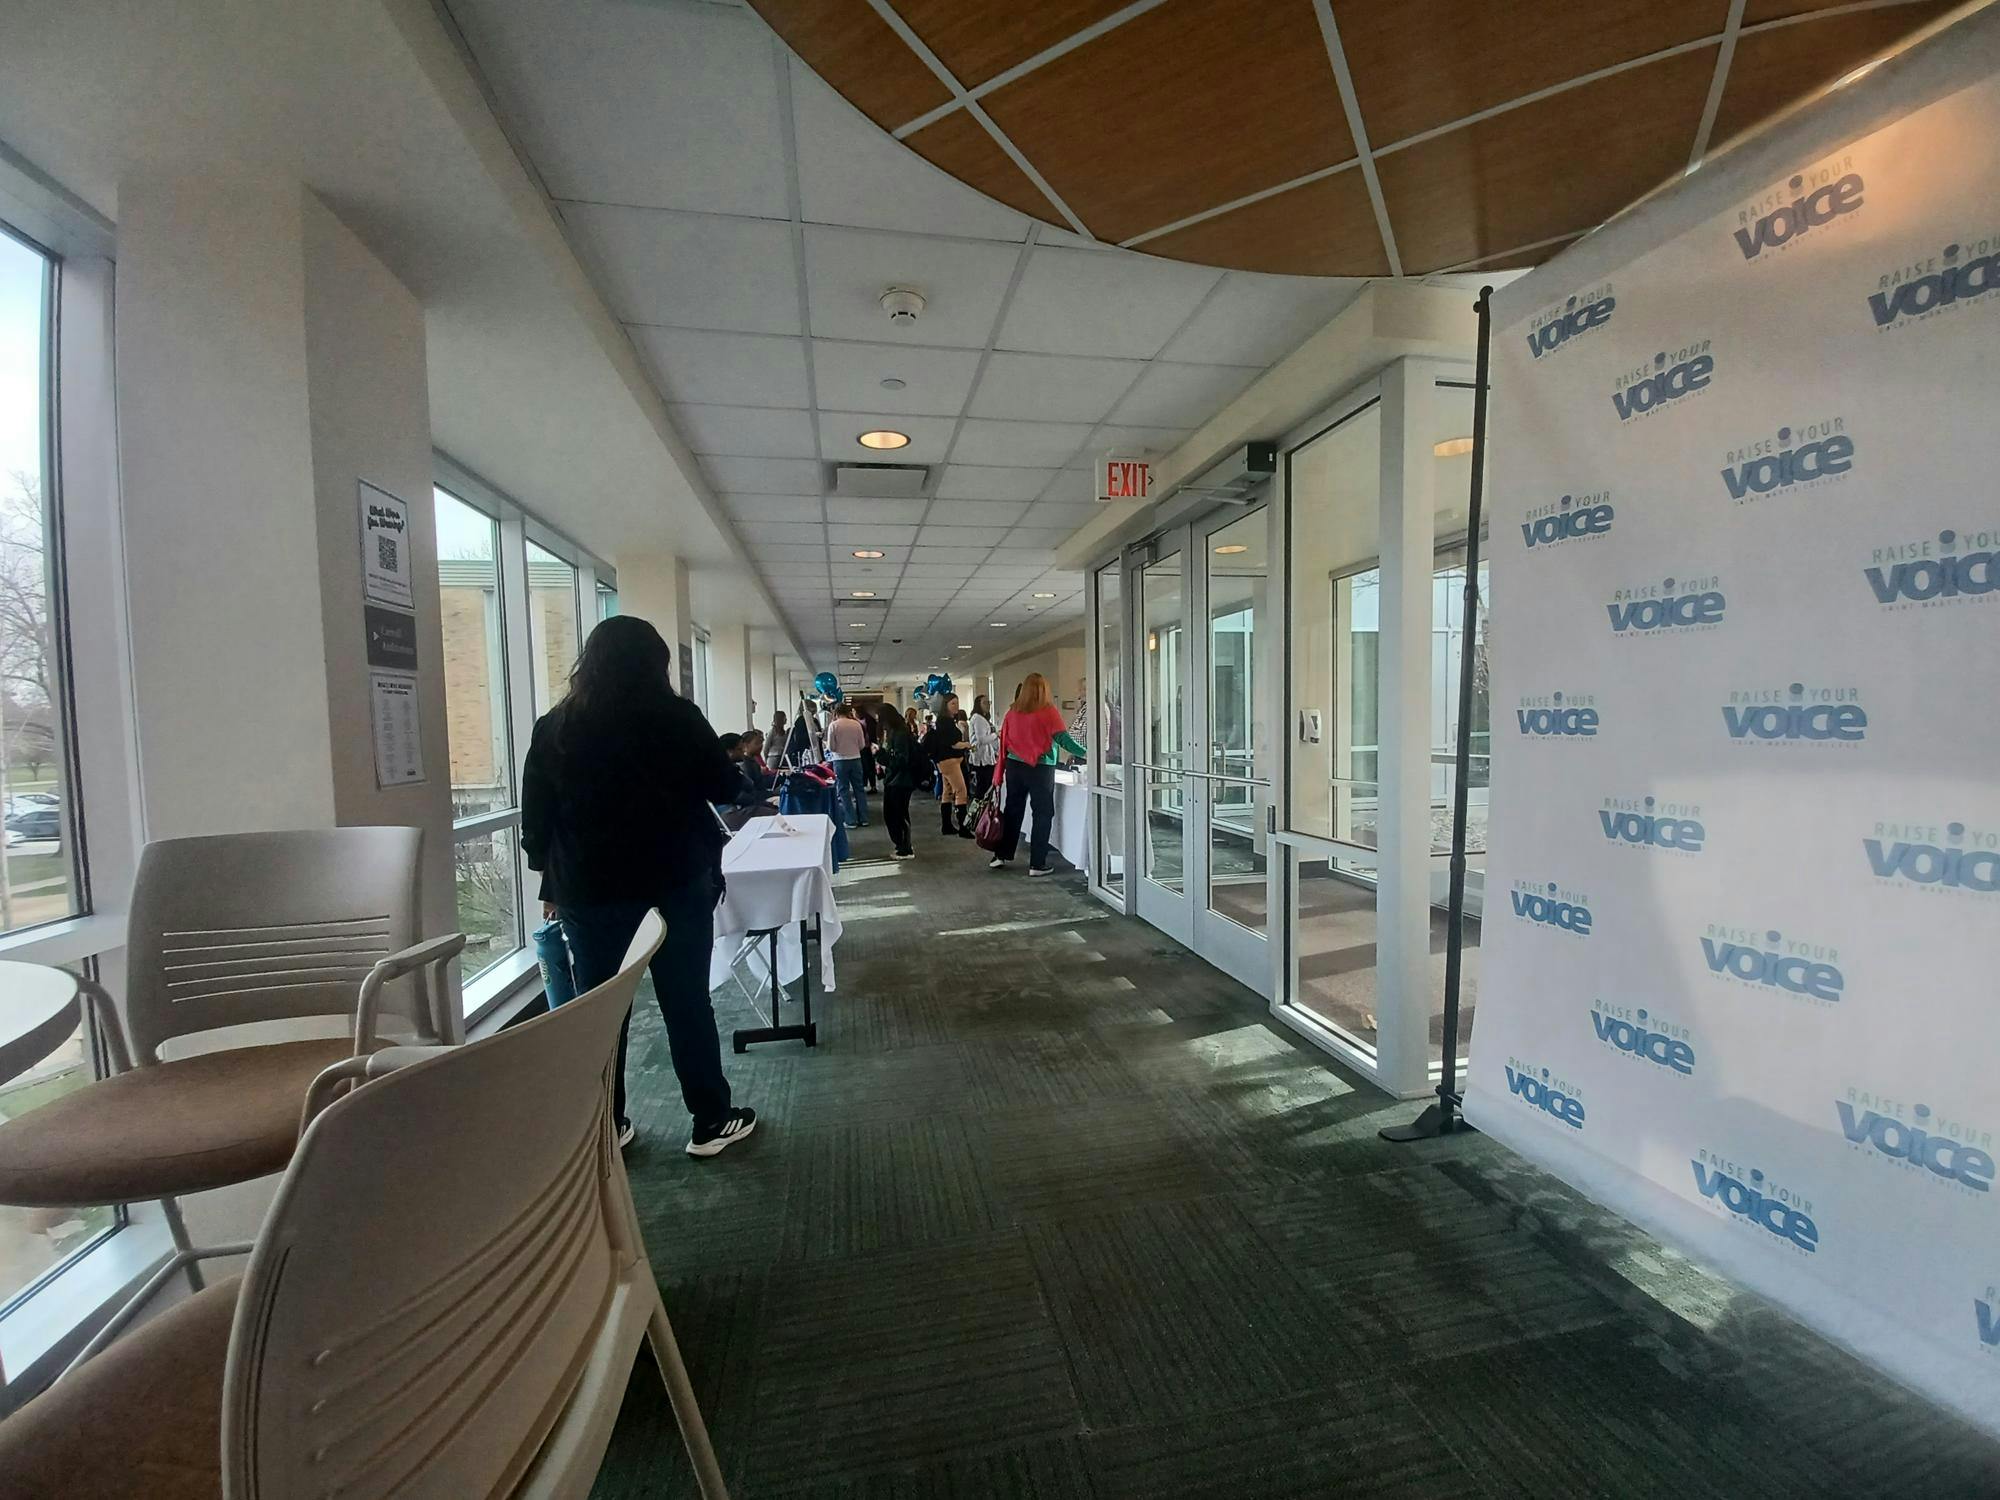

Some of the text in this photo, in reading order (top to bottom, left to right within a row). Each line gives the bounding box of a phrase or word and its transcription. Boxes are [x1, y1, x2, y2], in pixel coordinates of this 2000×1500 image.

[1738, 191, 1784, 224] RAISE
[1880, 235, 2000, 288] RAISE YOU
[1615, 339, 1711, 390] RAISE YOUR
[1726, 417, 1844, 464] RAISE YOUR
[1108, 463, 1149, 496] EXIT
[1526, 491, 1610, 519] RAISE YOUR
[1872, 530, 2000, 563] RAISE YOU
[1615, 576, 1719, 600] RAISE YOUR
[1566, 696, 1594, 705] YOUR
[1729, 688, 1858, 703] RAISE YOUR
[1604, 798, 1700, 817] RAISE YOUR
[1874, 822, 2000, 848] RAISE YO
[1560, 890, 1588, 904] YOUR
[1707, 923, 1838, 962] RAISE YOUR
[1595, 999, 1690, 1039] RAISE YOUR
[1508, 1056, 1537, 1076] RAISE
[1847, 1087, 1991, 1148] RAISE YOUR
[1699, 1149, 1812, 1213] RAISE YOUR
